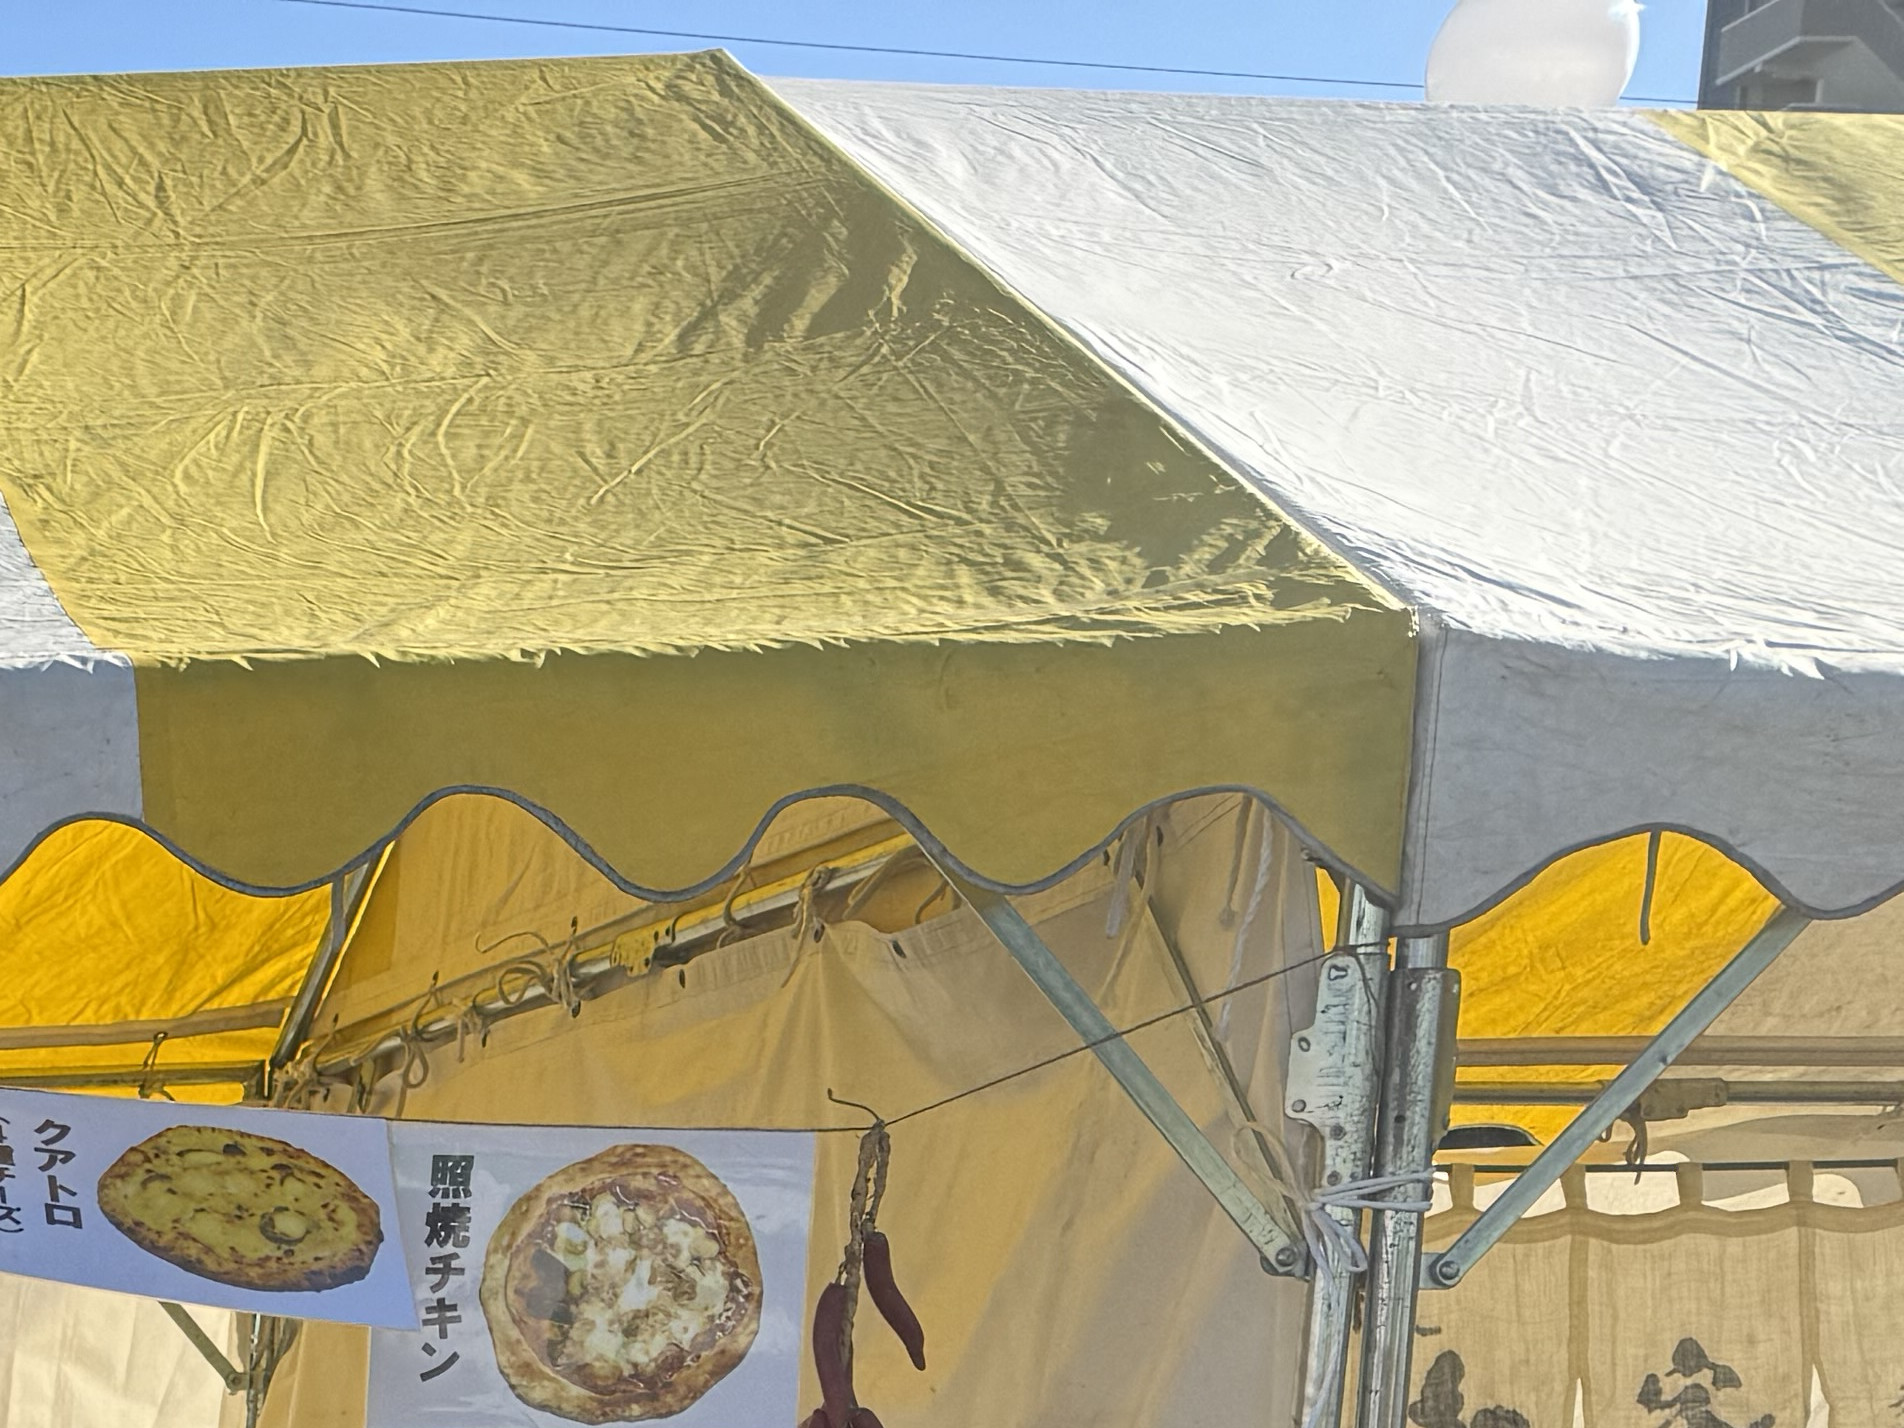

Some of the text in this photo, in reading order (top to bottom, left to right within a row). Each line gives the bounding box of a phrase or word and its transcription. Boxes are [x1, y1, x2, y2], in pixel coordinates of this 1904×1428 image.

[33, 1118, 84, 1230] クアトロ
[419, 1153, 476, 1385] 照焼チキン
